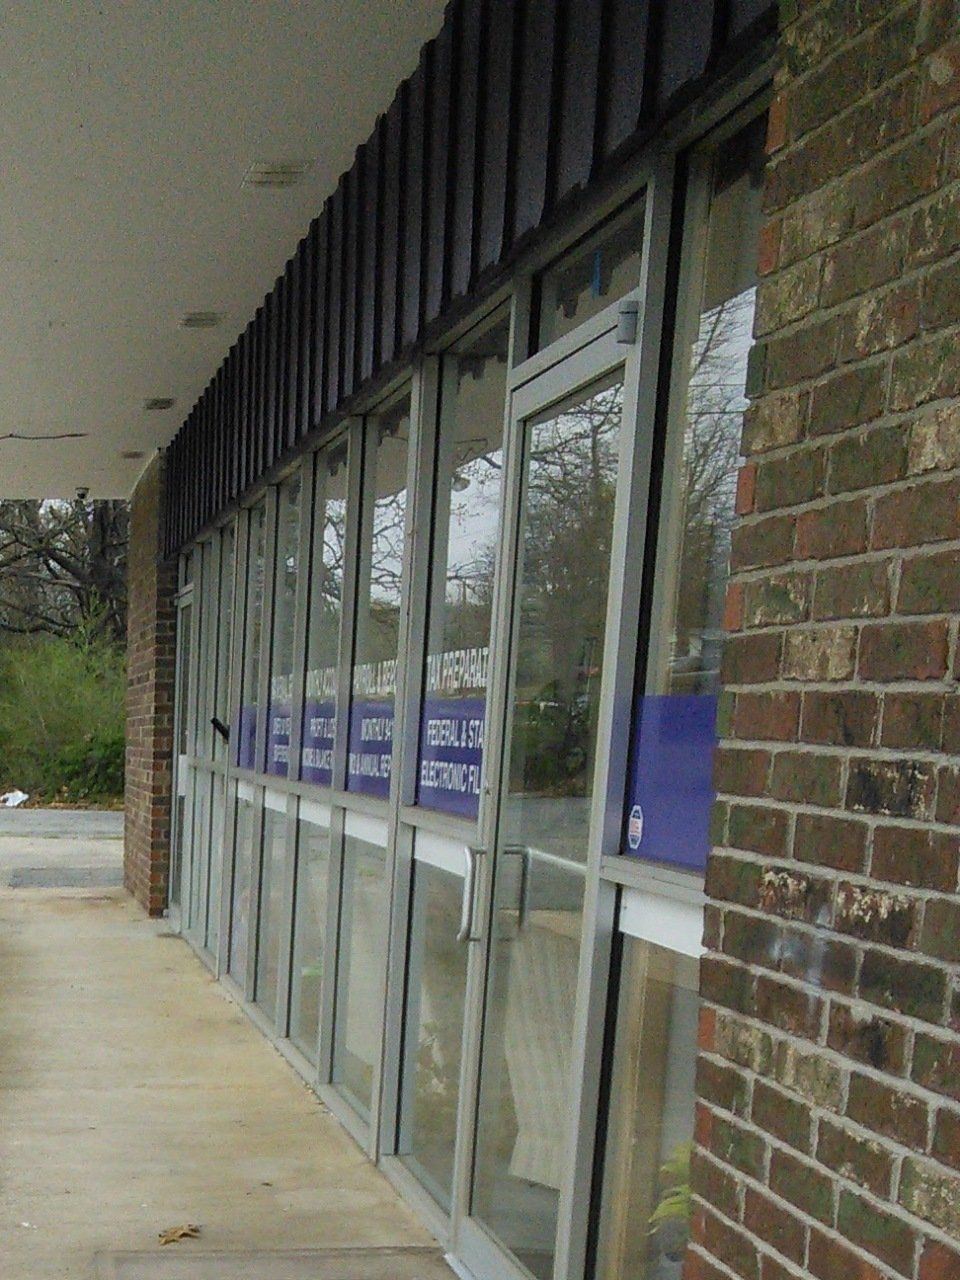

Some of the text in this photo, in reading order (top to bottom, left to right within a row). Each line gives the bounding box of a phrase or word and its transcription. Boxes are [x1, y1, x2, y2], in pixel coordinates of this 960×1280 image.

[427, 654, 442, 691] TAX
[427, 719, 460, 747] FEDERAL
[460, 720, 467, 748] &
[420, 760, 467, 792] ELECTRONIC
